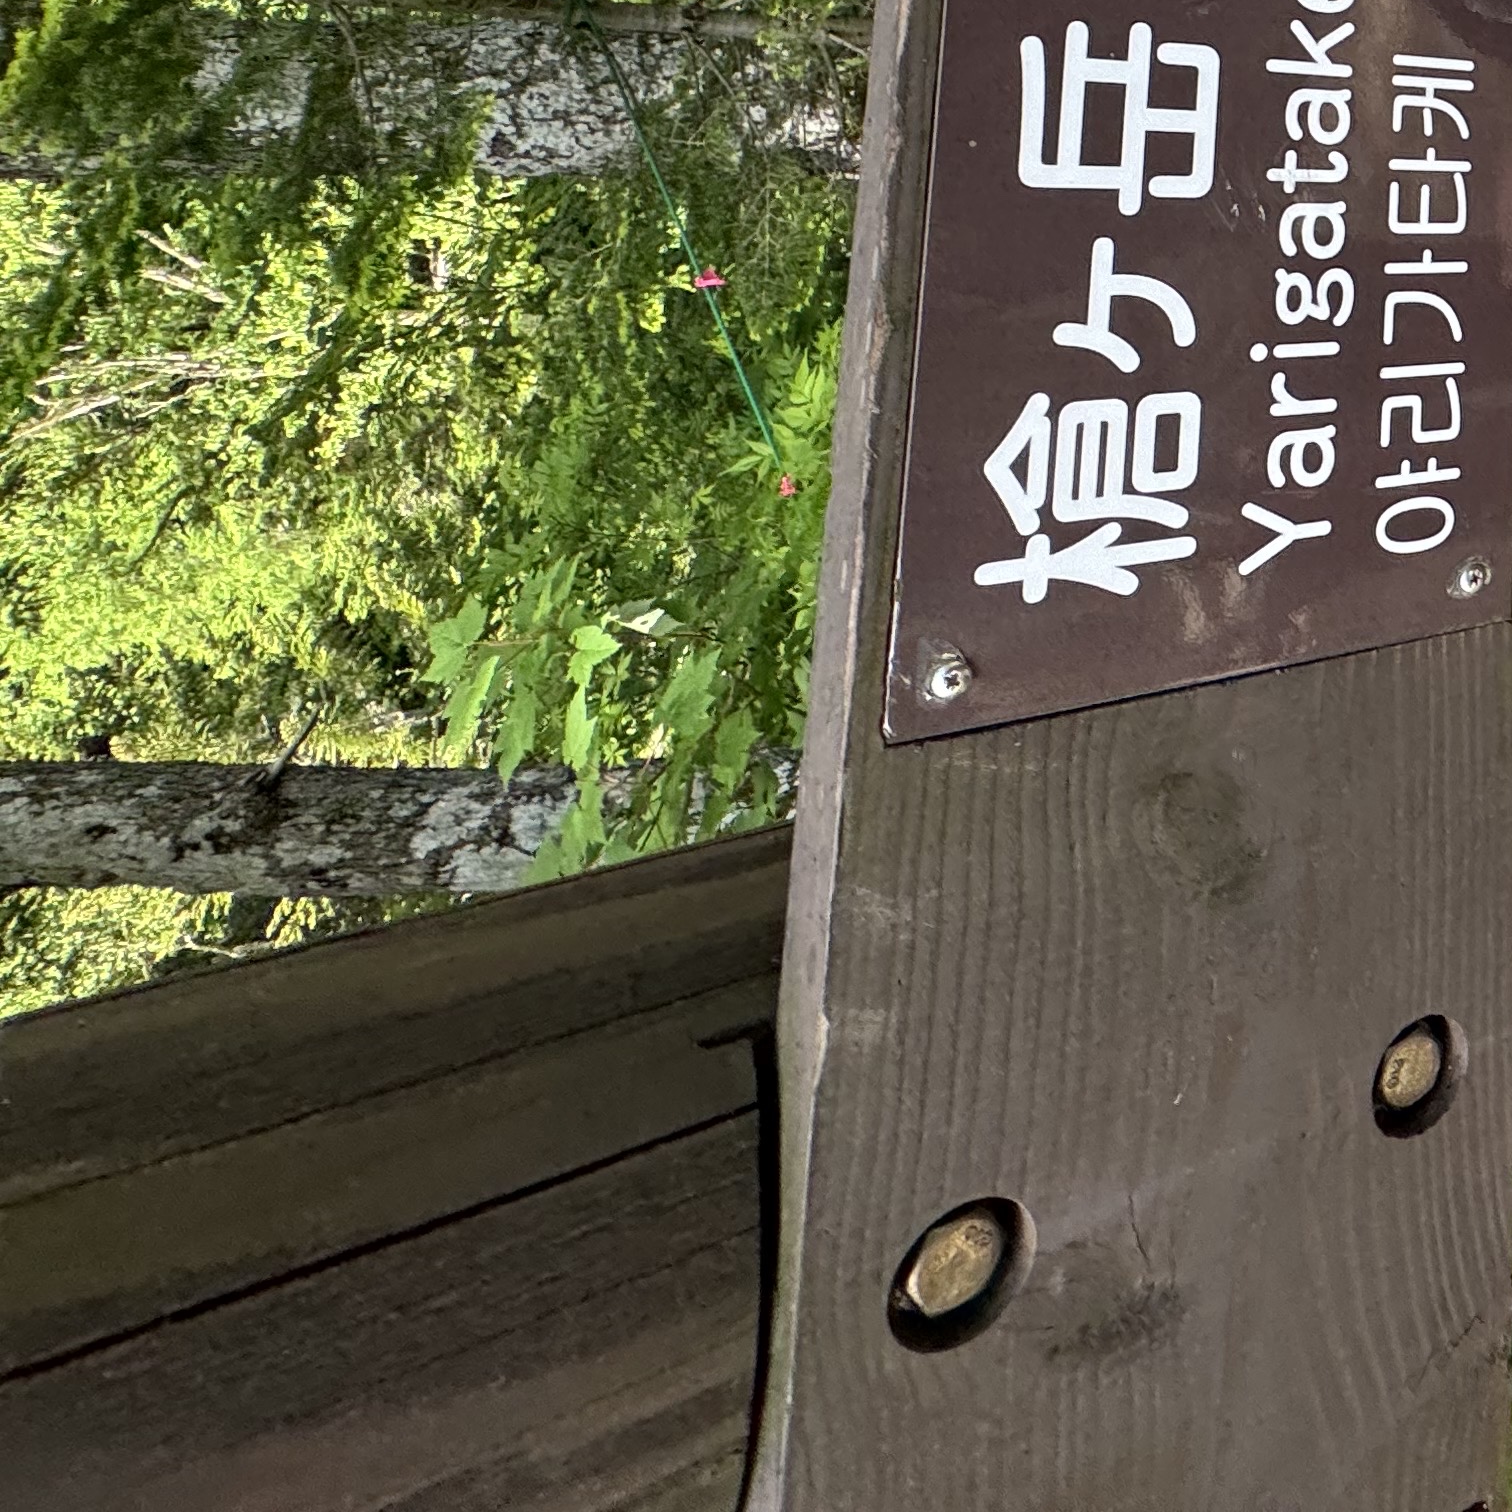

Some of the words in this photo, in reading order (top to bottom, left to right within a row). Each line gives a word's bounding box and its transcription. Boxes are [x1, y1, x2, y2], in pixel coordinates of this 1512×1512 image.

[974, 20, 1221, 604] 槍ヶ岳
[1374, 53, 1475, 554] 야리가타케
